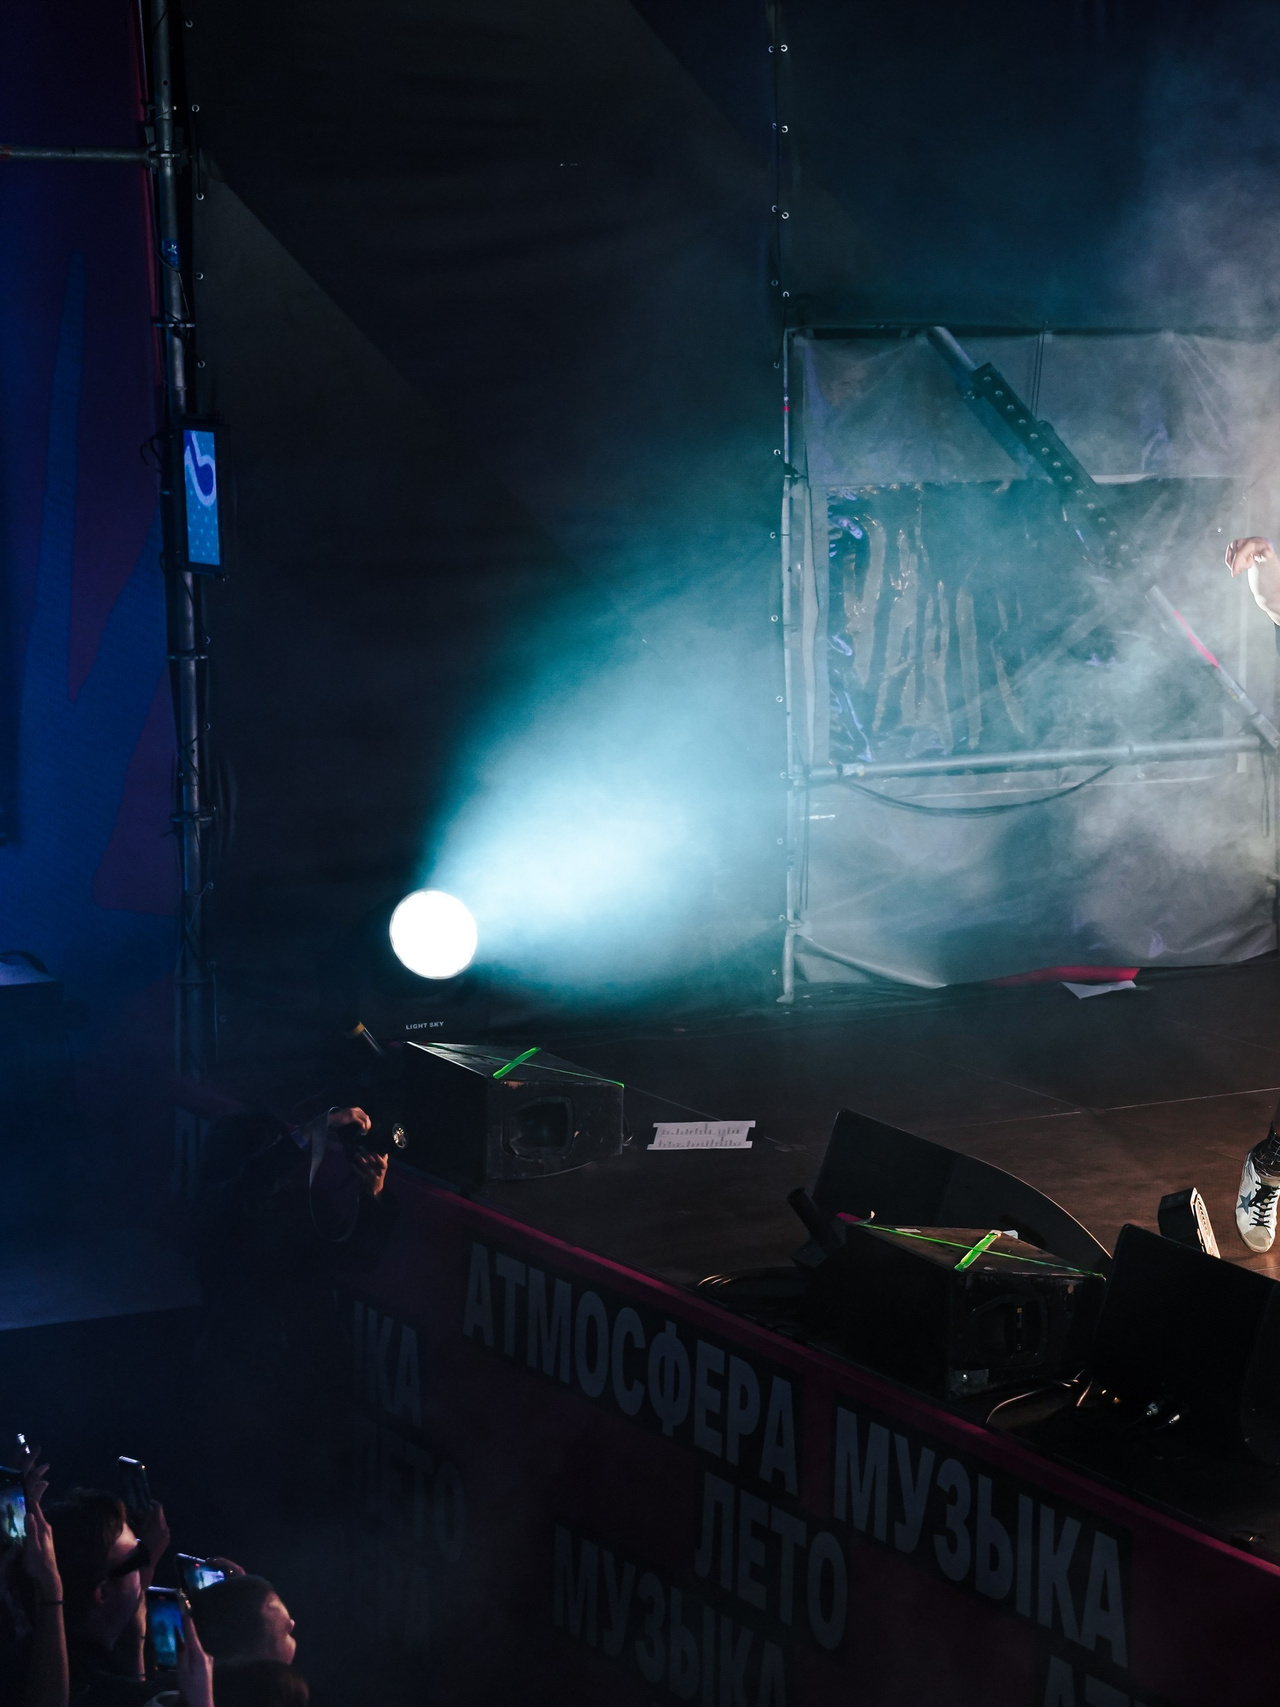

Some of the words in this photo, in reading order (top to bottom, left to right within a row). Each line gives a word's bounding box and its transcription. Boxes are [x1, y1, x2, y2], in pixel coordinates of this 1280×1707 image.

[405, 1022, 428, 1030] LIGHT
[463, 1241, 799, 1498] АТМОСФЕРА
[832, 1407, 1129, 1670] МУЗЫКА
[552, 1522, 789, 1707] МУЗЫКА
[694, 1471, 849, 1652] ЛЕТО
